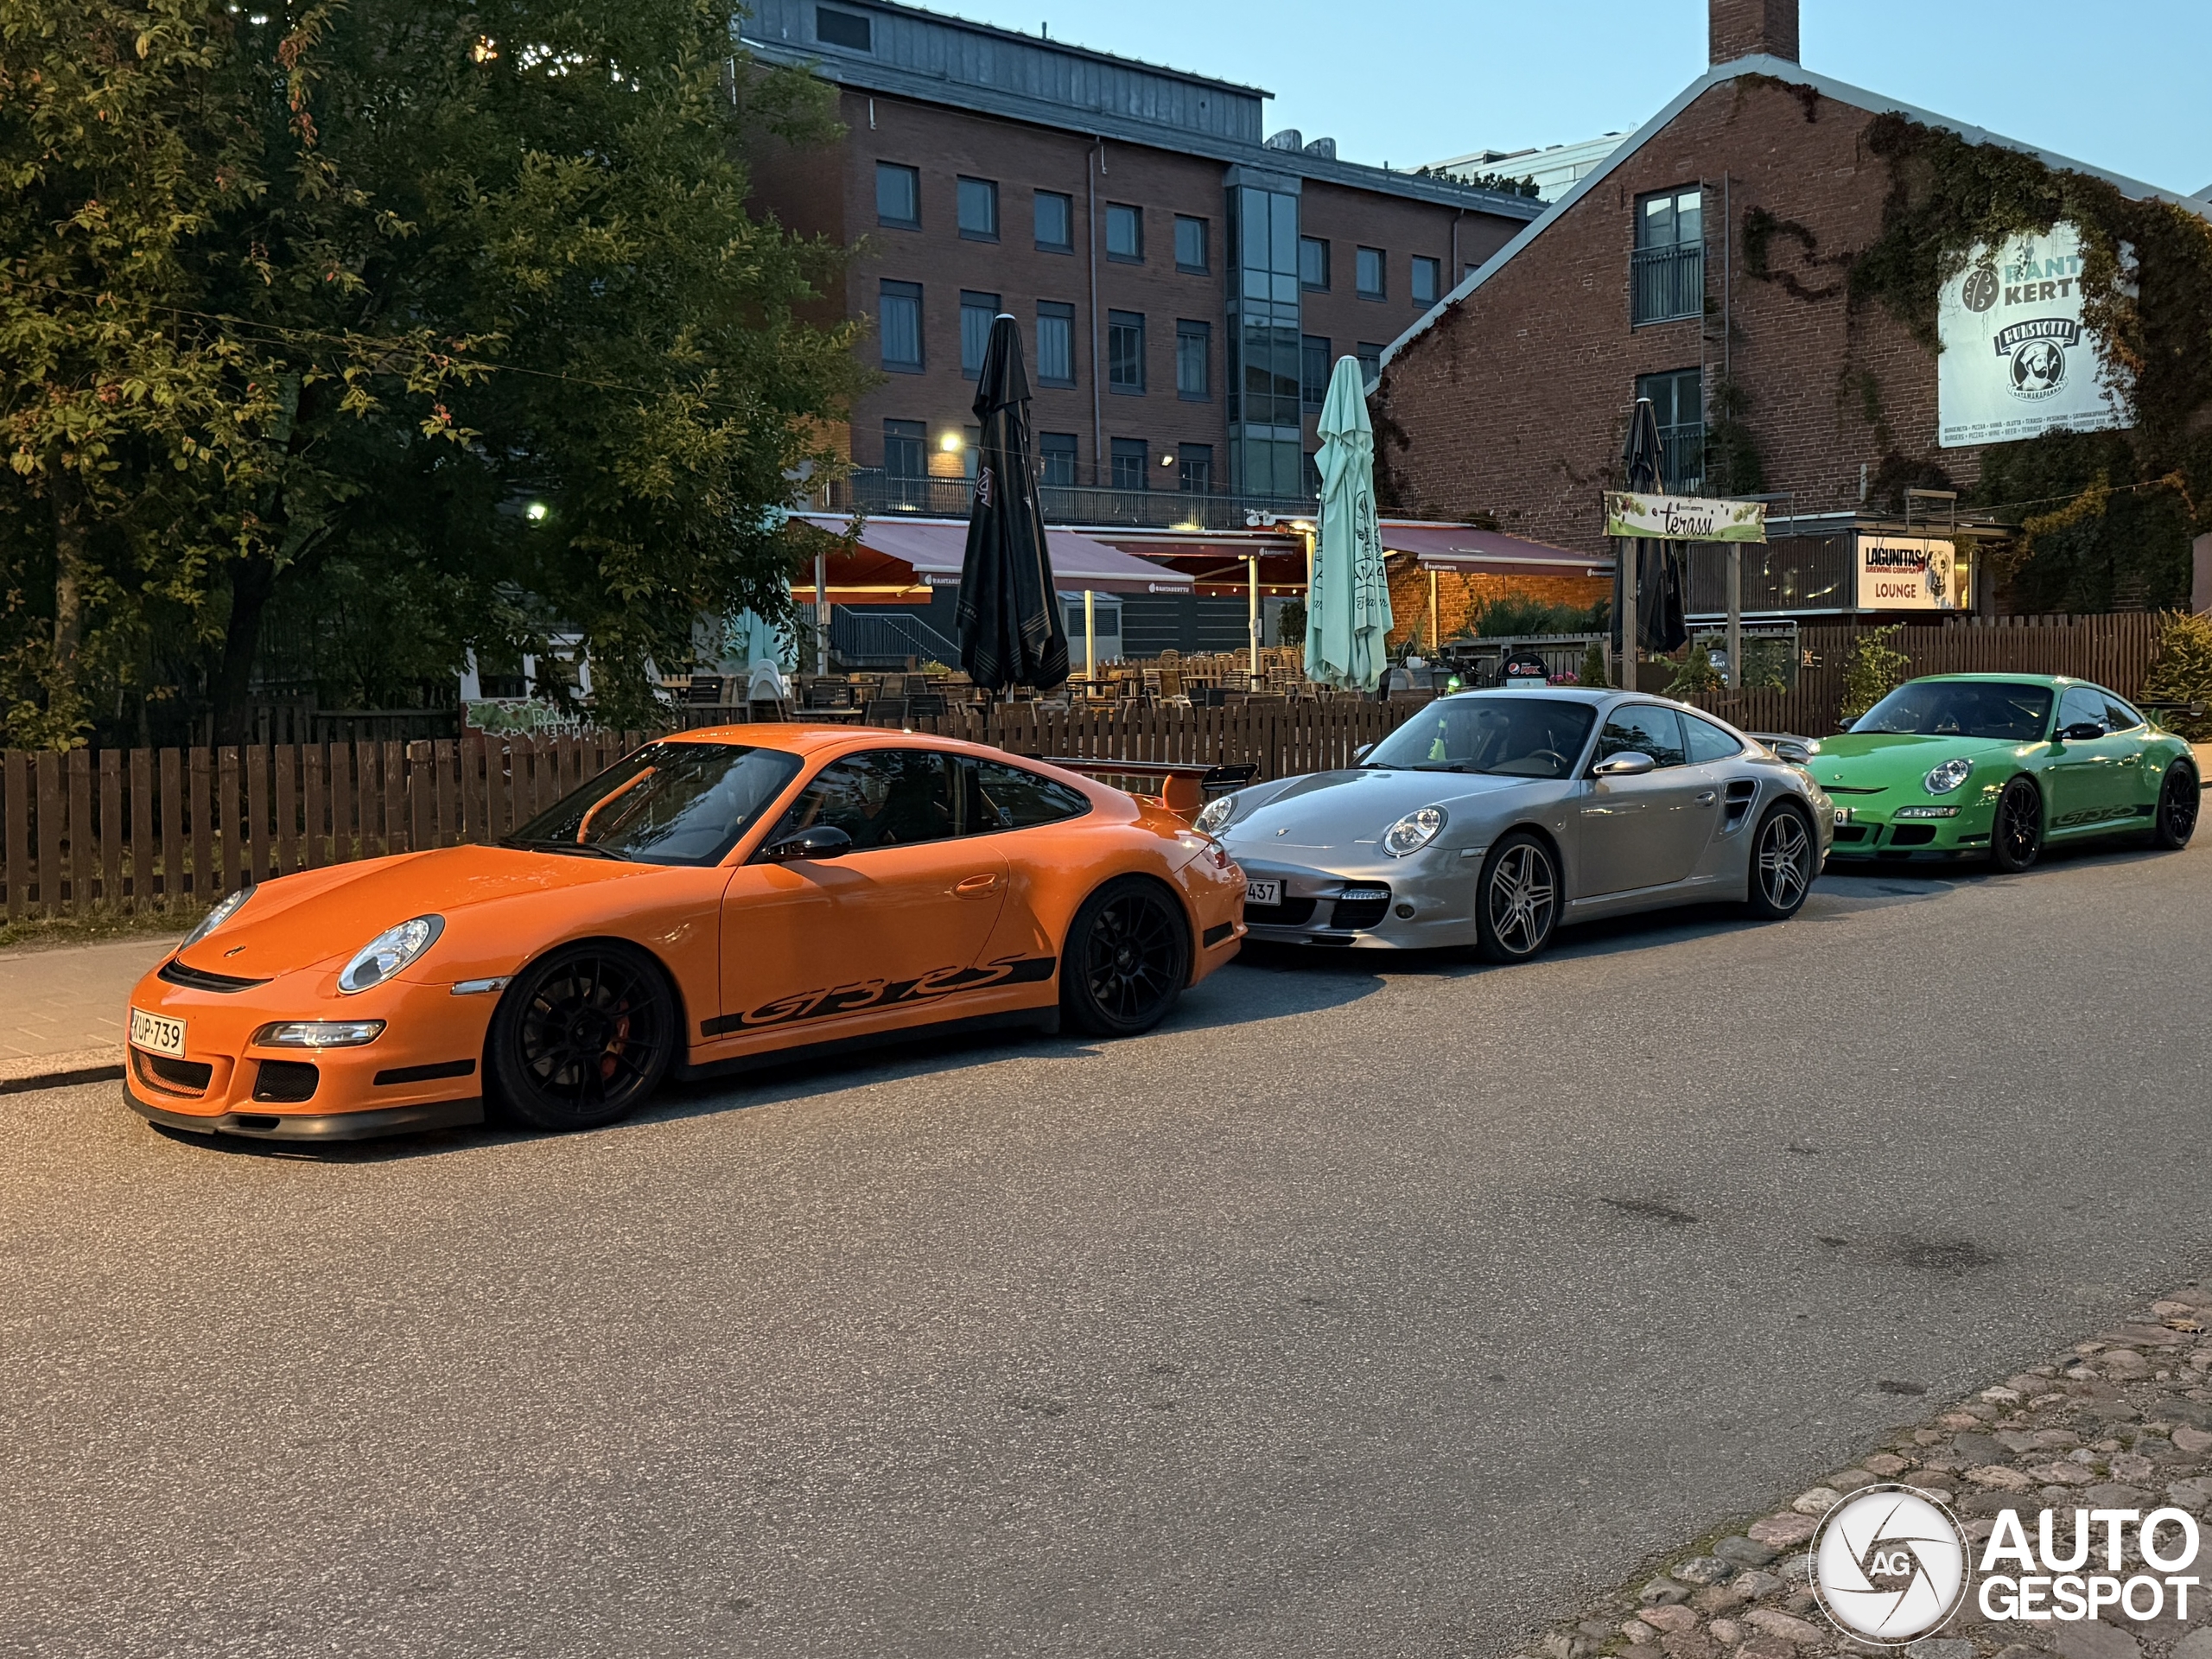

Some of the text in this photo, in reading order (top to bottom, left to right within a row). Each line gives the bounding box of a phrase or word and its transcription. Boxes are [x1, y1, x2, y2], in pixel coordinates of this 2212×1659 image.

[2005, 256, 2080, 283] RANT
[2005, 277, 2085, 306] KERTT
[1660, 502, 1714, 536] terassi
[1866, 547, 1923, 567] LAGUNITAS
[1876, 583, 1916, 598] LOUNGE
[741, 979, 893, 1025] GT3
